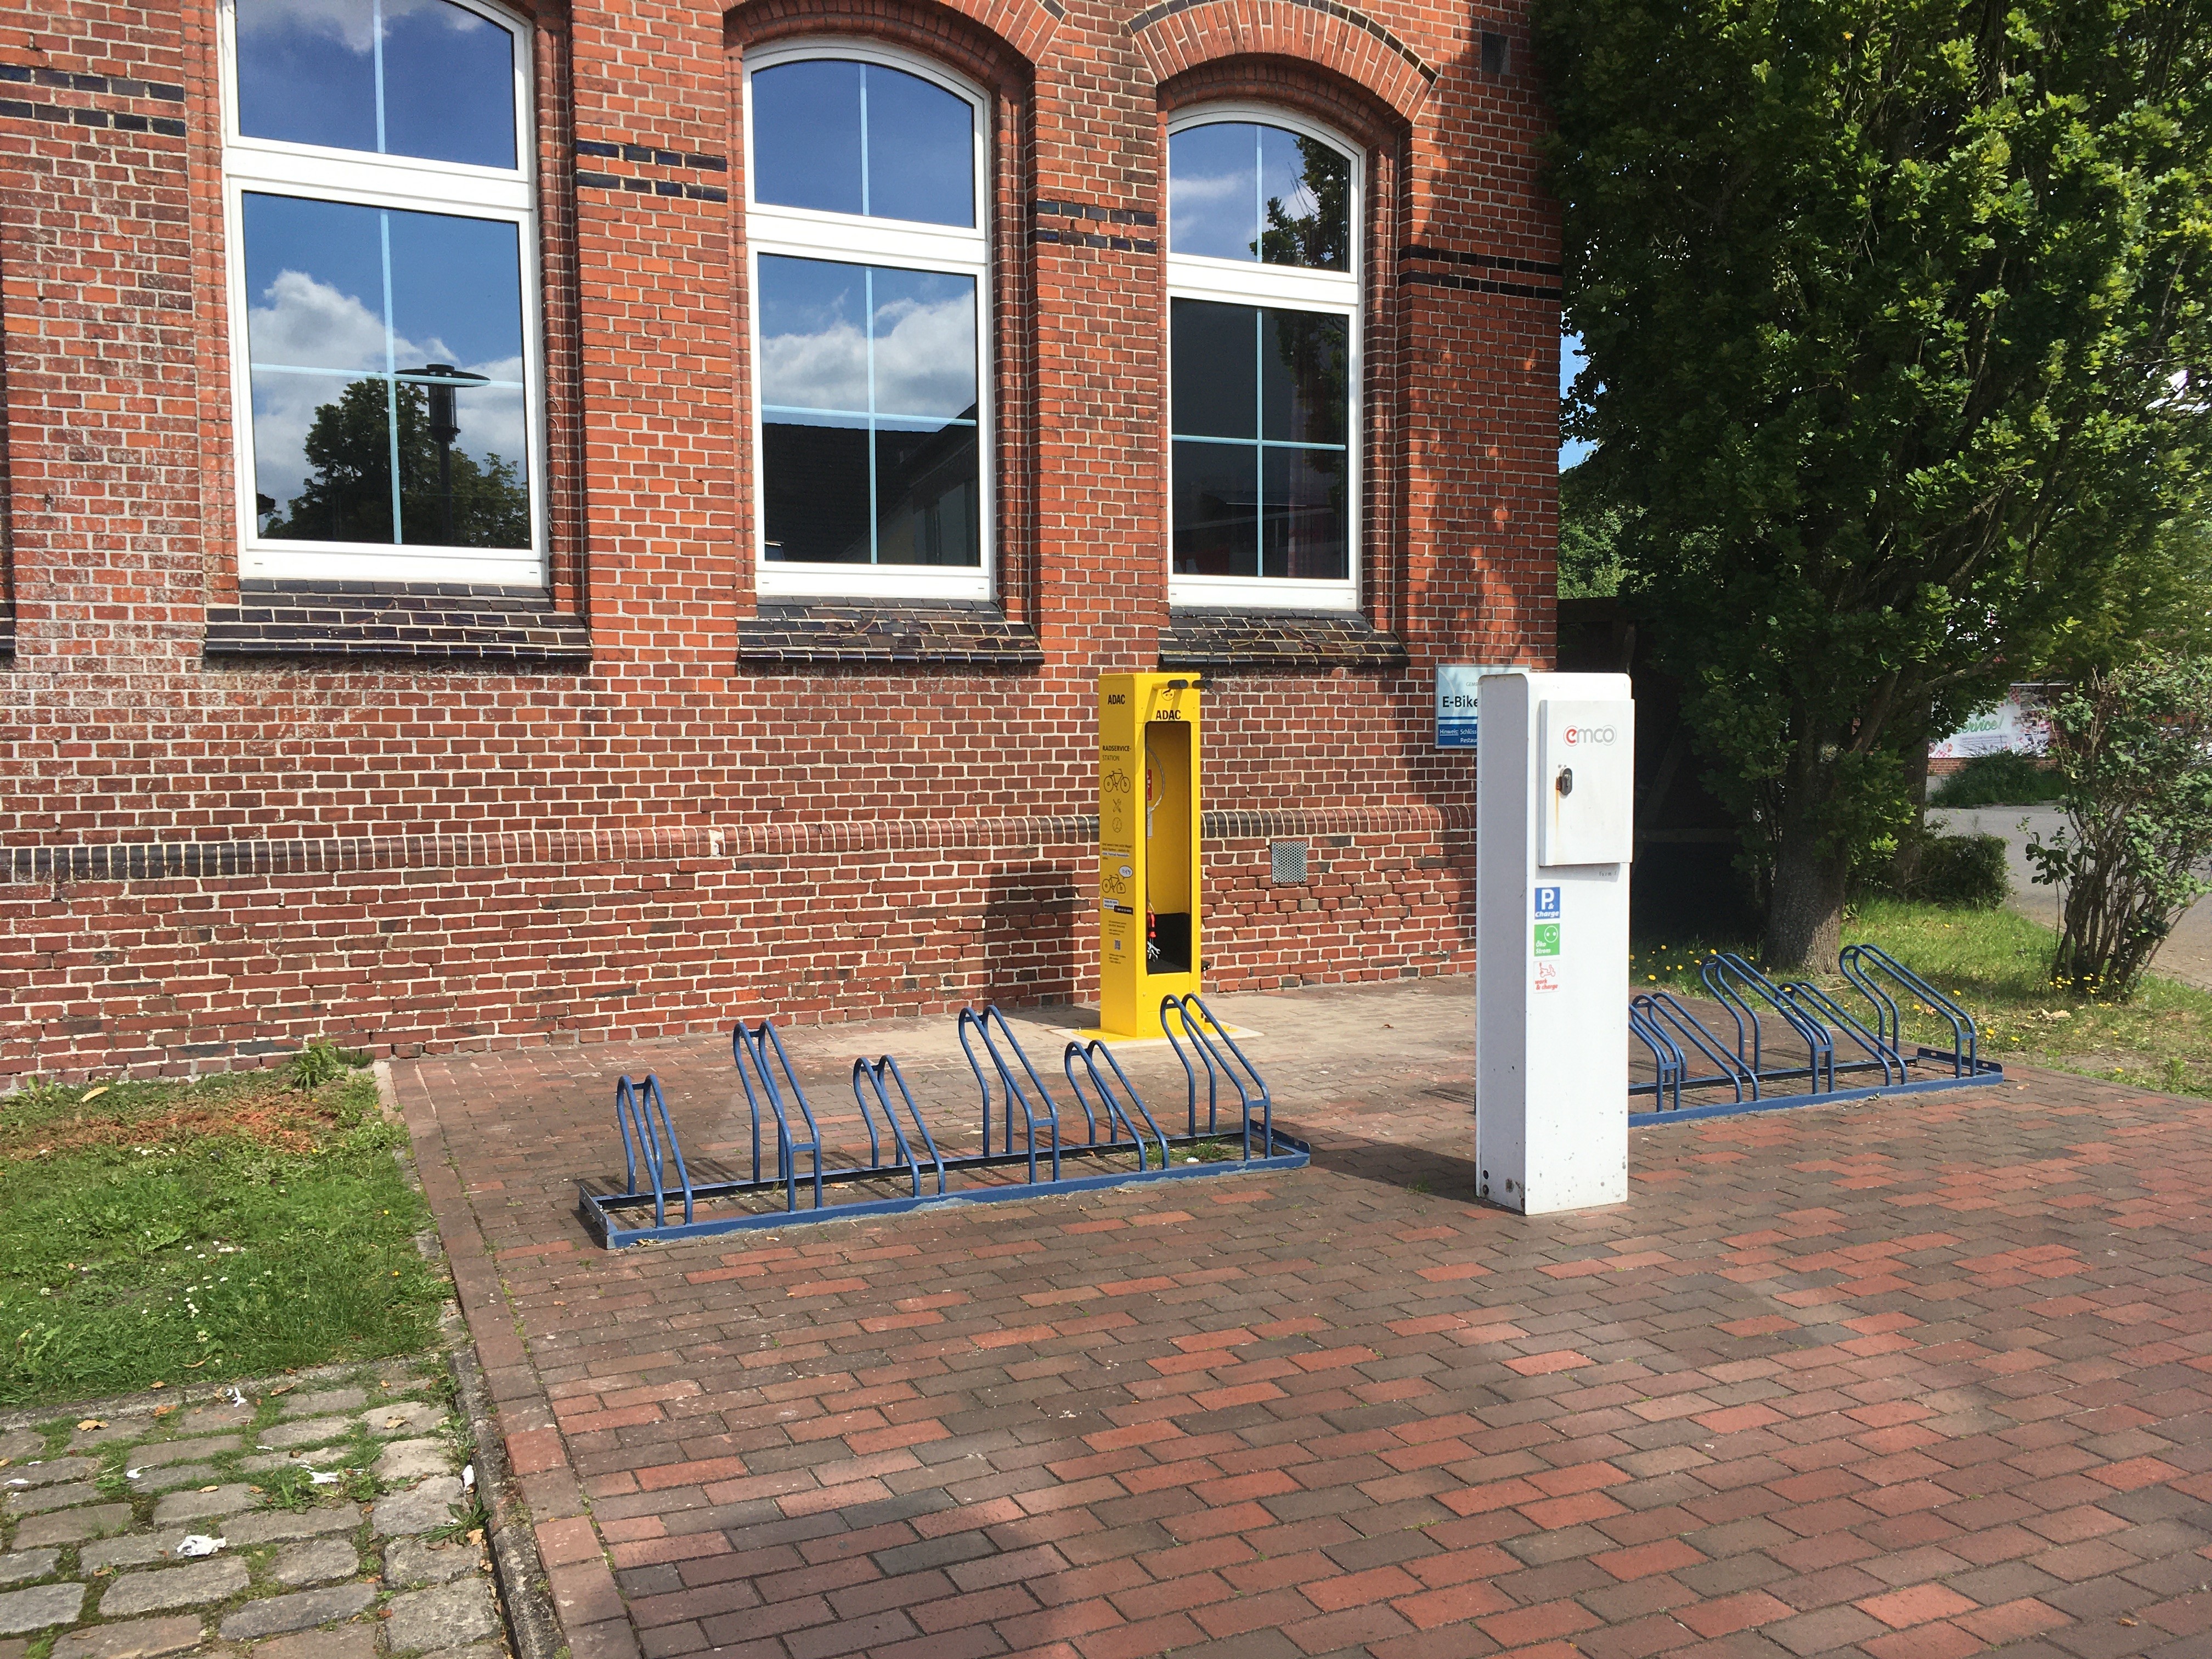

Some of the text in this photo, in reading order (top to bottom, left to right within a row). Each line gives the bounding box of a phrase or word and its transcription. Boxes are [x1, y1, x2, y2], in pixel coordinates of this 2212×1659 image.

[1108, 694, 1125, 705] ADAC
[1442, 695, 1478, 708] E-Bike
[1155, 709, 1181, 720] ADAC
[1565, 727, 1615, 744] emco
[1541, 889, 1554, 910] P
